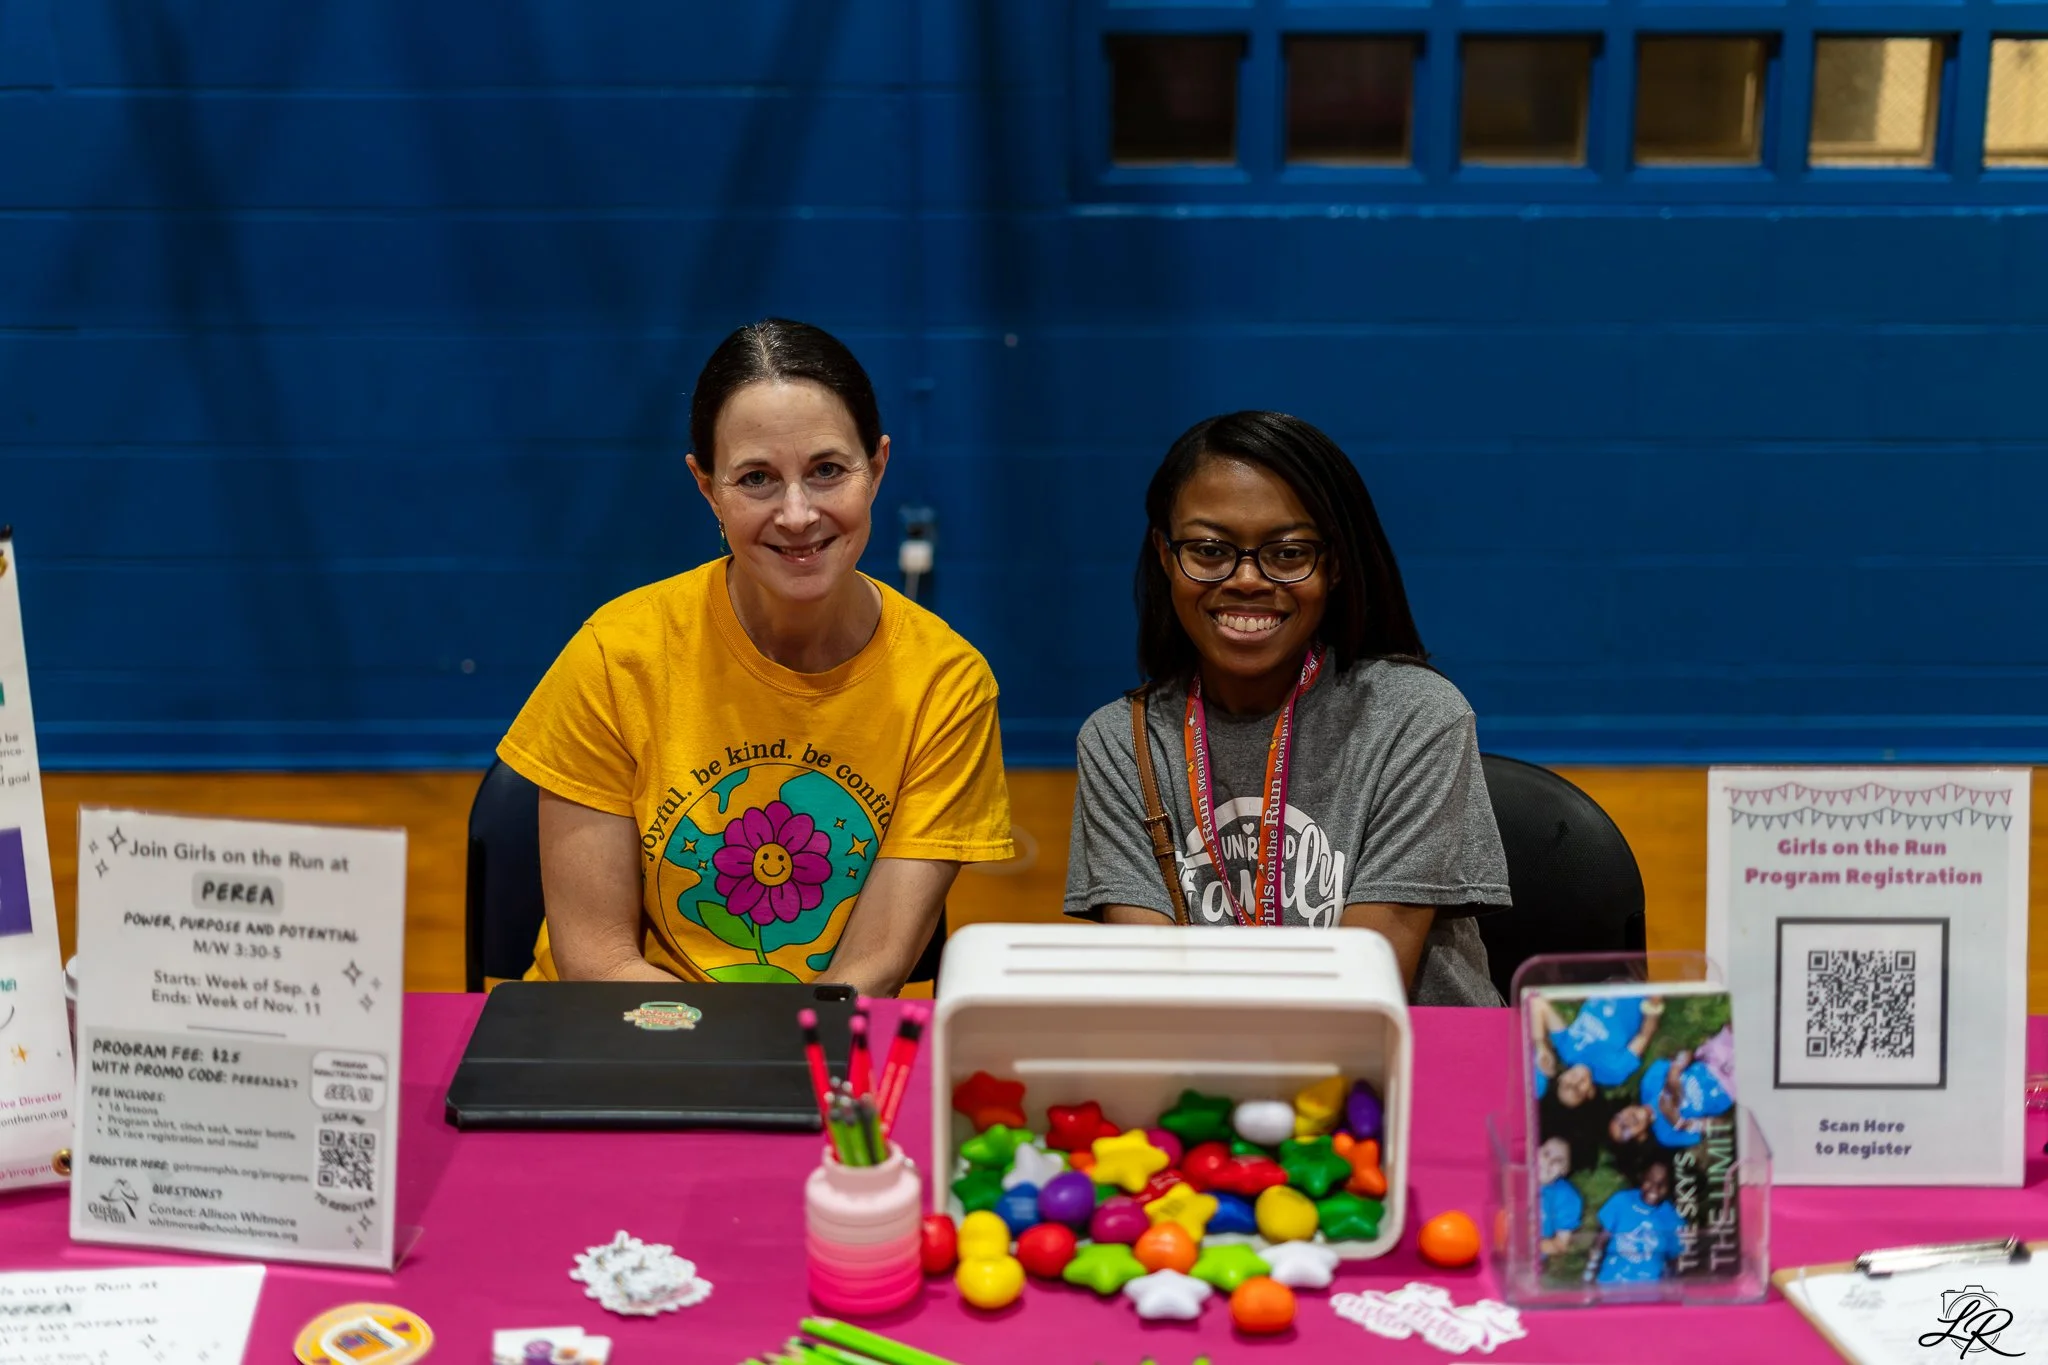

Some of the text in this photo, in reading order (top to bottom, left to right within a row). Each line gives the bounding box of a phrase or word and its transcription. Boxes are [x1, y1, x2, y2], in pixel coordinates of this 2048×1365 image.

[1193, 727, 1207, 792] Memphis
[7, 772, 31, 787] goal
[641, 787, 692, 862] joyful.
[690, 760, 722, 786] be
[725, 740, 793, 767] kind.
[801, 743, 832, 768] be
[1198, 794, 1215, 845] Run
[1260, 706, 1290, 928] irls on the Run Memphis
[129, 840, 349, 872] Join Girls on the Run at
[1777, 838, 1947, 857] Girls on the Run
[1744, 866, 1983, 890] Program Registration
[201, 880, 275, 906] PEREA
[124, 911, 359, 943] POWER, PURPOSE AND POTENTIAL
[192, 939, 282, 960] M/W 3:30-5
[154, 970, 321, 998] Starts: Week of Sep. 6
[152, 988, 321, 1016] Ends: Week of Nov. 11
[93, 1038, 241, 1064] PROGRAM FEE: $25
[92, 1060, 130, 1075] WITH
[134, 1062, 184, 1079] PROMO
[188, 1068, 228, 1083] CODE:
[19, 1092, 62, 1107] Director
[91, 1085, 165, 1102] FEE INCLUDES:
[109, 1102, 158, 1116] 16 lessons
[107, 1127, 259, 1149] 5K race registration and medal
[108, 1115, 149, 1128] Program
[153, 1118, 177, 1131] shirt,
[180, 1122, 205, 1132] cinch
[235, 1127, 262, 1137] water
[266, 1128, 296, 1140] bottle
[1819, 1119, 1905, 1133] Scan Here
[1815, 1141, 1912, 1159] to Register
[88, 1154, 138, 1169] REGISTER
[141, 1159, 169, 1172] HERE:
[152, 1183, 223, 1200] QUESTIONS?
[1707, 1118, 1737, 1272] THE LIMIT
[149, 1203, 297, 1228] Contact: Allison Whitmore
[1674, 1151, 1699, 1272] THE SKY'S
